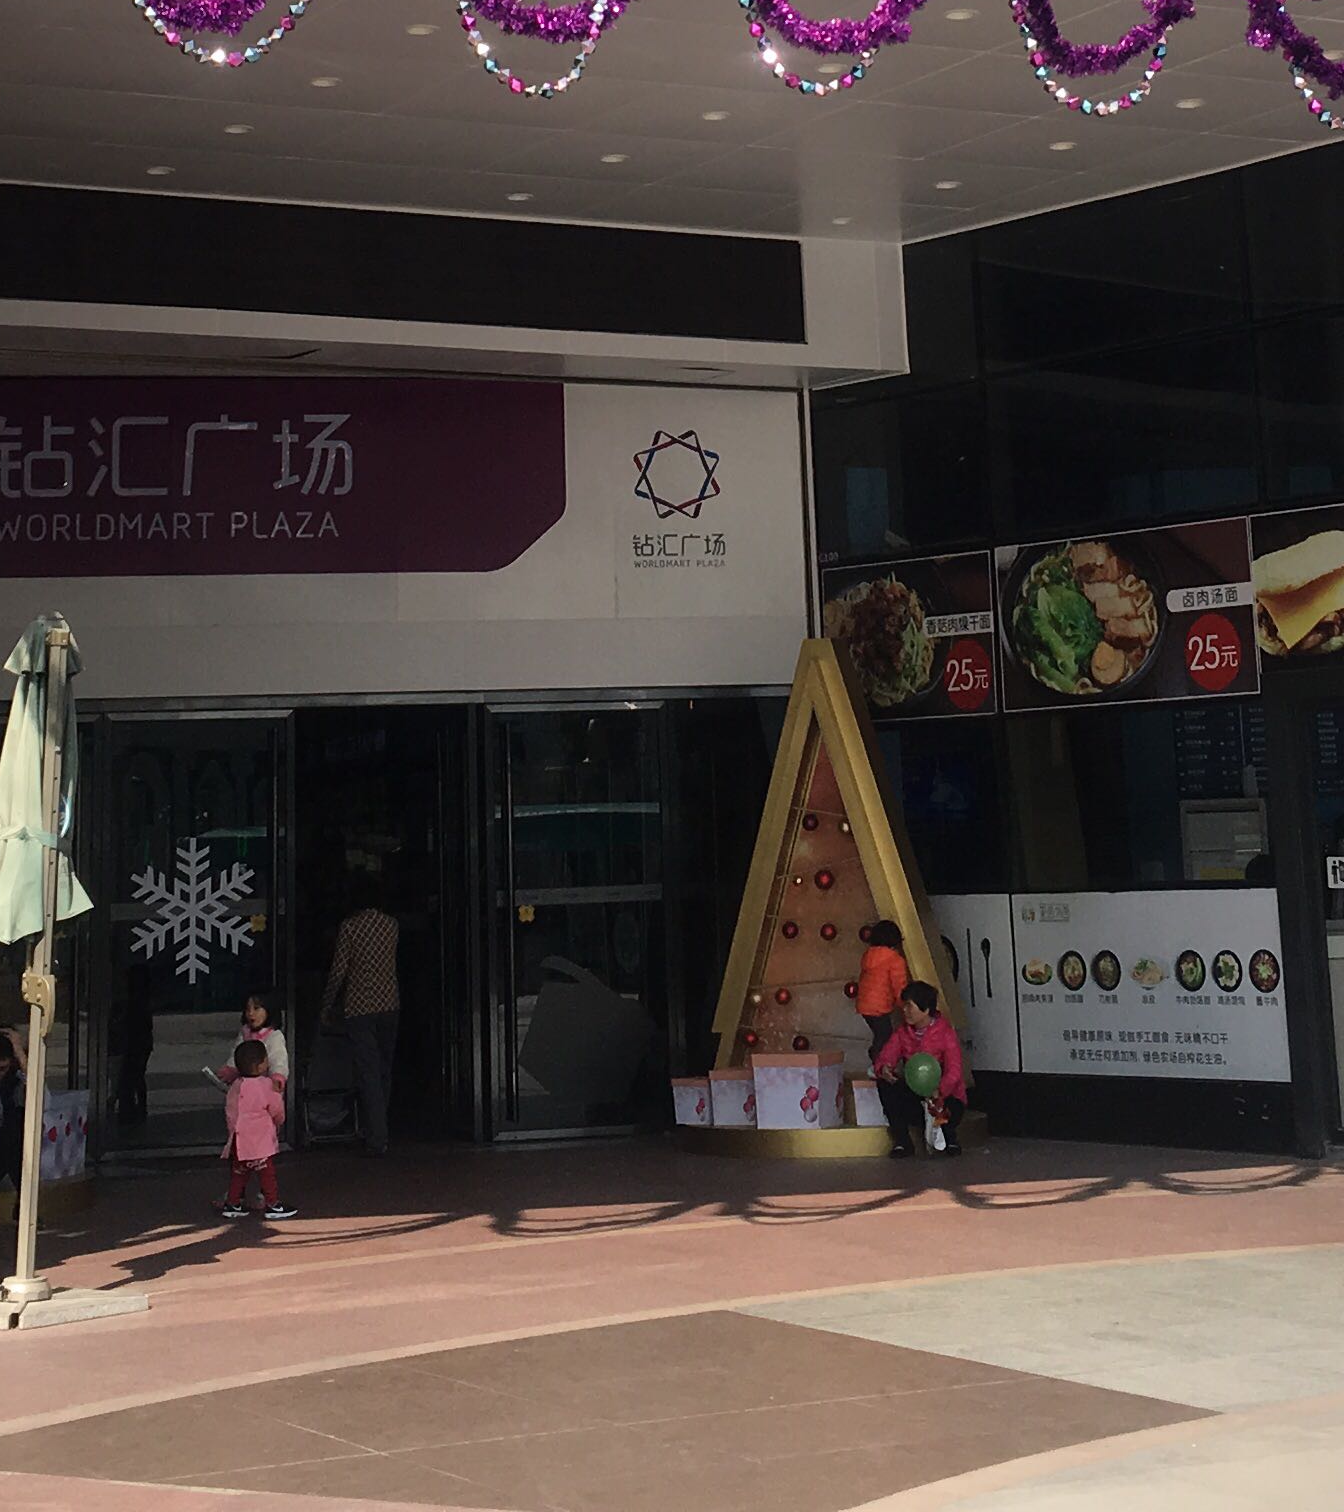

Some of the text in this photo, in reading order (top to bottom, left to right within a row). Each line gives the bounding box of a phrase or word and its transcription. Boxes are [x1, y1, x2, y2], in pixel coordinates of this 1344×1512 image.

[229, 510, 340, 539] PLAZA
[632, 533, 727, 558] 钻汇广场
[633, 558, 727, 568] WORLDMART PLAZA
[1182, 587, 1239, 609] 卤肉汤面
[1187, 634, 1238, 671] 25元
[946, 658, 989, 693] 25元
